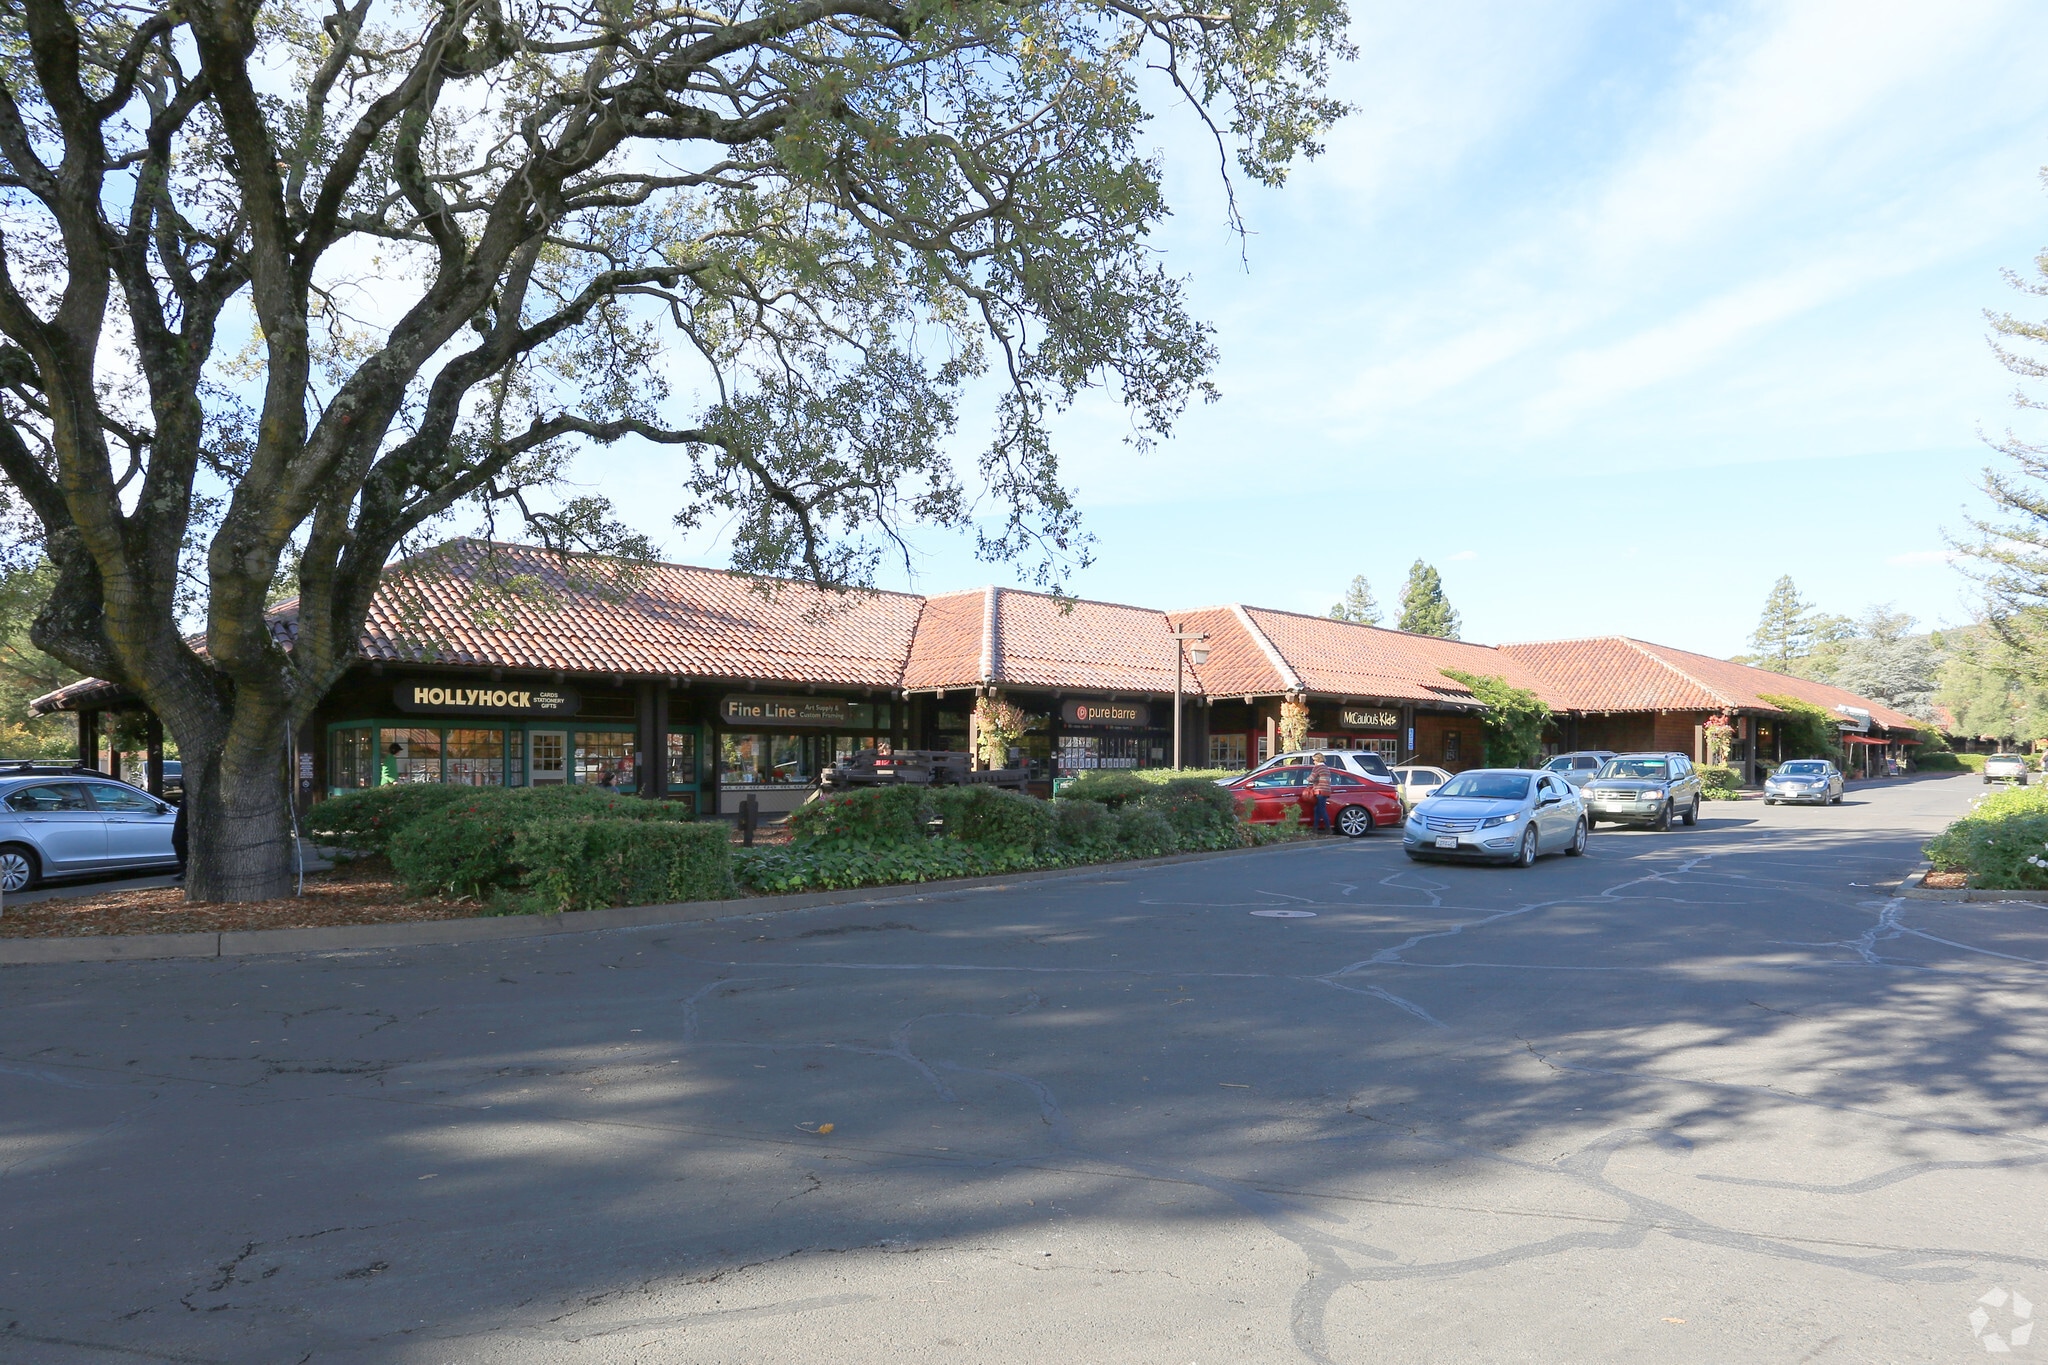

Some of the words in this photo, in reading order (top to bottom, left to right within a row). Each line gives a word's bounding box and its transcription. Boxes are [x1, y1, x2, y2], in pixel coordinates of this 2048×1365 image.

[414, 687, 531, 708] HOLLYHOCK
[728, 701, 761, 717] Fine
[765, 703, 796, 718] Line
[816, 704, 834, 712] Supply
[1088, 707, 1111, 721] pure
[1111, 706, 1136, 719] barre
[822, 712, 844, 720] Framing
[1379, 711, 1397, 727] Kids
